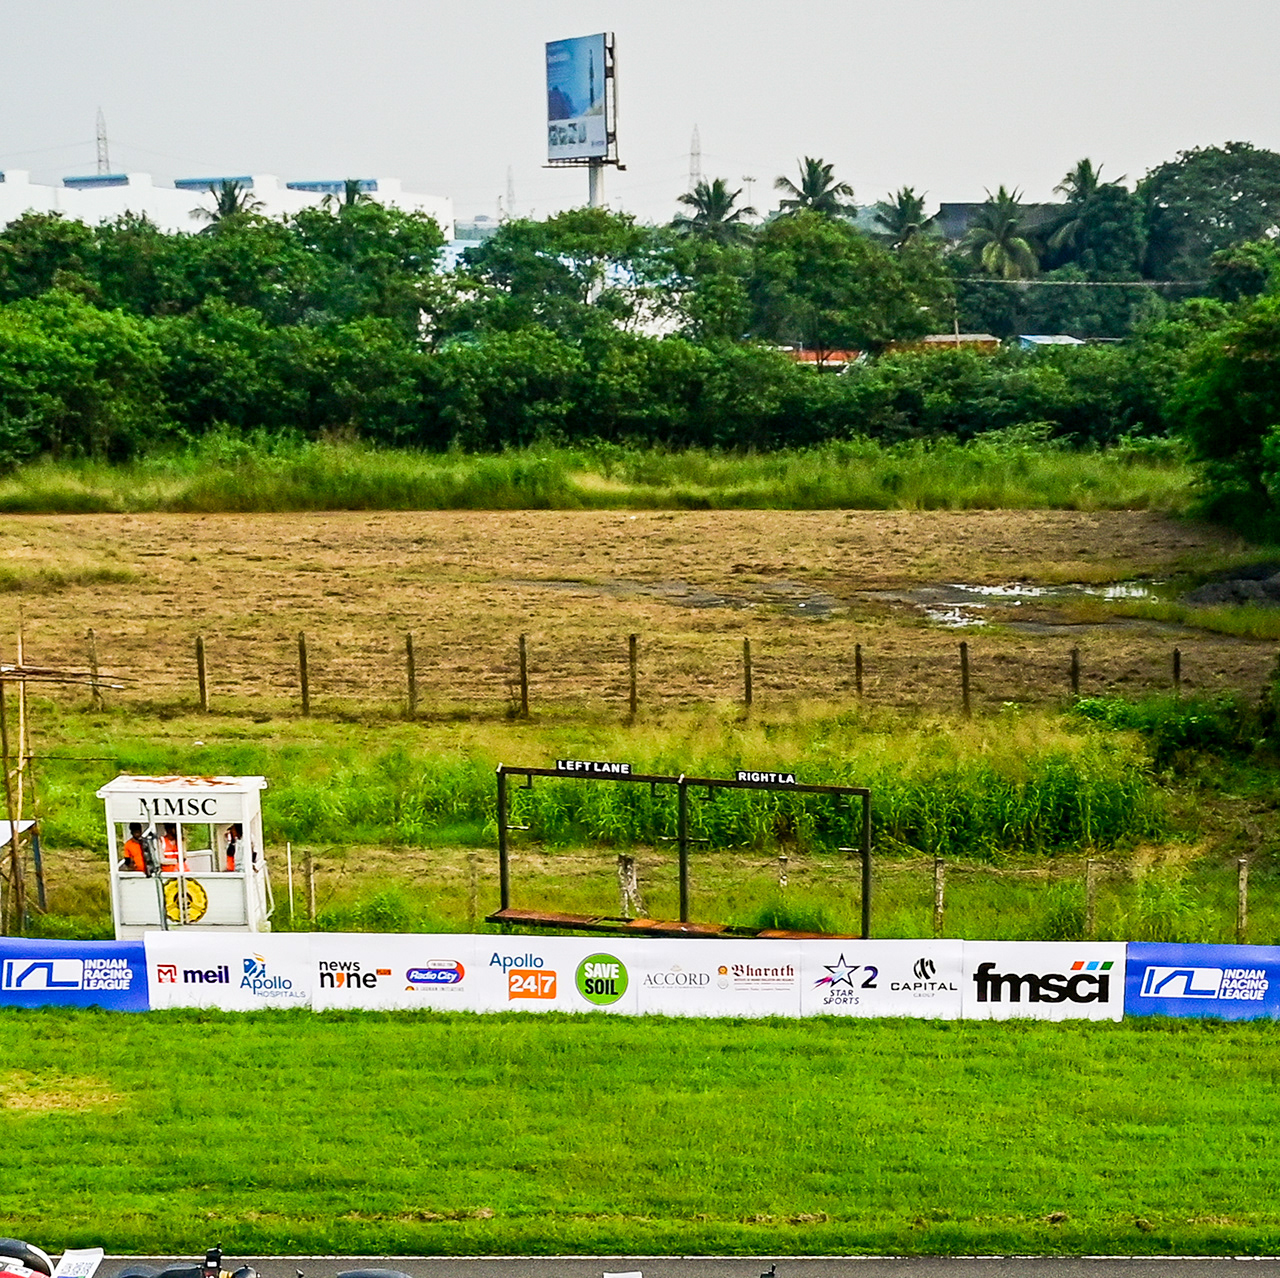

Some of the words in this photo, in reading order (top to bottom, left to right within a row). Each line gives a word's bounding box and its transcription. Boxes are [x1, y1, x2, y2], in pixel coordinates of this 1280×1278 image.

[558, 760, 590, 772] LEFT
[593, 762, 630, 775] LANE
[738, 771, 777, 784] RIGHT
[138, 797, 218, 816] MMSC
[85, 959, 128, 969] INDIAN
[319, 960, 361, 972] news
[489, 952, 544, 974] Apollo
[84, 969, 133, 980] RACING
[183, 965, 230, 984] meil
[409, 969, 435, 981] Radio
[436, 969, 458, 983] City
[584, 963, 619, 979] SAVE
[731, 964, 795, 977] Bharath
[1224, 969, 1266, 980] INDIAN
[643, 973, 711, 985] ACCORD
[860, 965, 879, 990] 2
[973, 963, 1110, 1003] fmsci
[83, 979, 131, 991] LEAGUE
[240, 974, 293, 995] Apollo
[584, 979, 619, 996] SOIL
[890, 982, 958, 992] CAPITAL
[1222, 979, 1269, 991] RACING
[257, 990, 307, 998] HOSPITALS
[829, 989, 854, 997] STAR
[1219, 989, 1265, 1001] LEAGUE
[823, 996, 860, 1005] SPORTS
